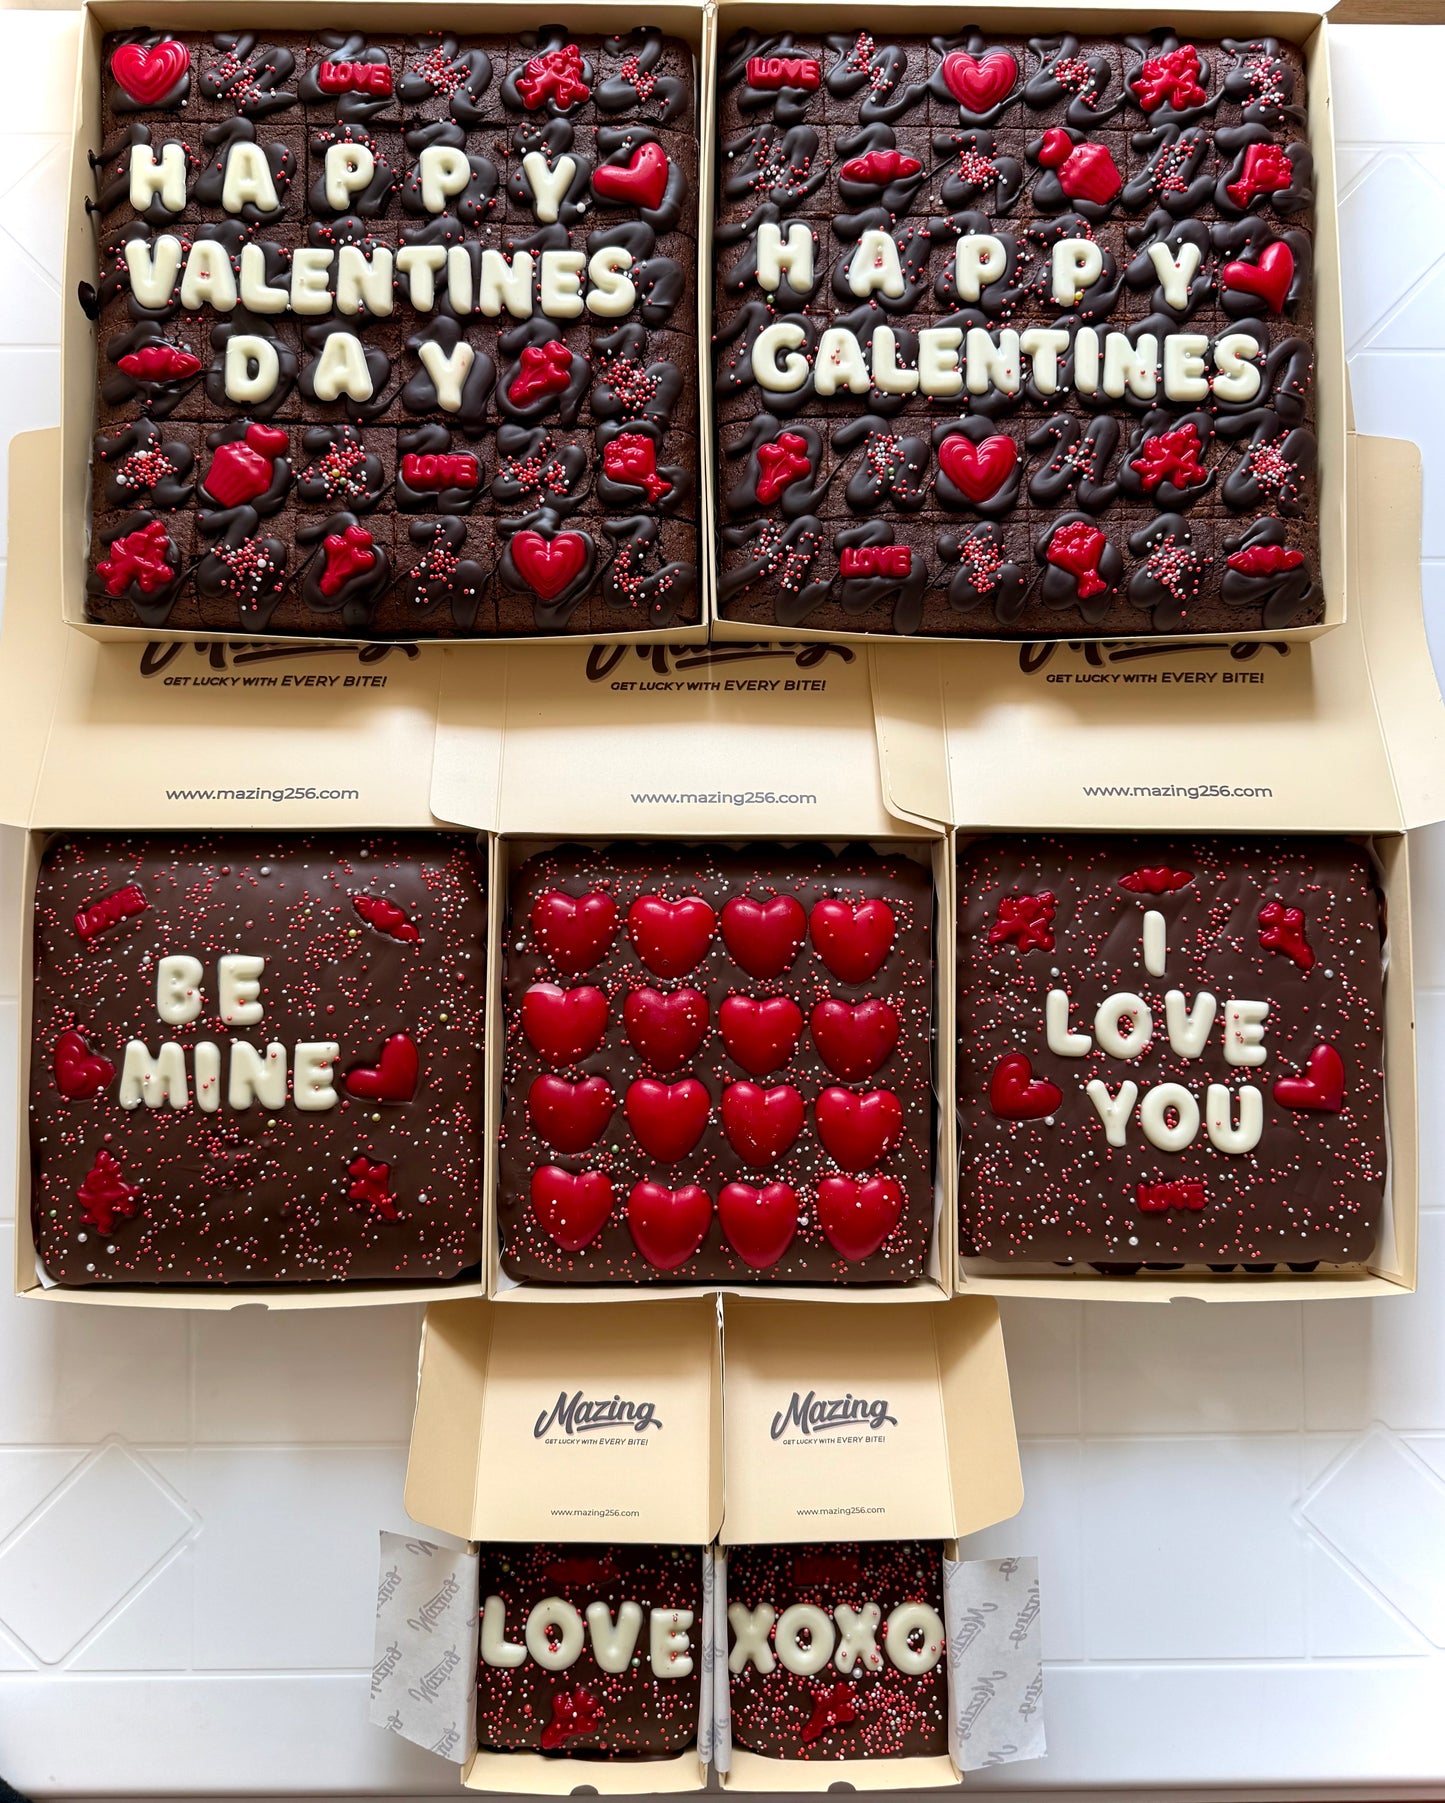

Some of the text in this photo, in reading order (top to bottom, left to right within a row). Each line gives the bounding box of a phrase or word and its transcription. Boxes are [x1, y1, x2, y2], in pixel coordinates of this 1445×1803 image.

[130, 142, 576, 223] HAPPY
[125, 235, 636, 318] VALENTINES
[757, 223, 1201, 310] HAPPY
[225, 331, 475, 412] DAY
[751, 323, 1261, 401] GALENTINES
[163, 675, 388, 688] GET LUCKY WITH EVERY BITE!
[611, 680, 826, 691] GET LUCKY WITH EVERY BITE!
[1046, 672, 1264, 683] GET LUCKY WITH EVERY BITE!
[166, 787, 359, 802] www.mazing256.com
[631, 791, 817, 806] www.mazing256.com
[1083, 784, 1273, 799] www.mazing256.com
[1143, 910, 1167, 978] I
[157, 955, 265, 1026] BE
[1046, 989, 1269, 1067] LOVE
[119, 1039, 341, 1113] MINE
[1086, 1079, 1264, 1155] YOU
[533, 1390, 662, 1438] Mazing
[599, 1438, 627, 1446] EVERY
[770, 1390, 898, 1440] Mazing
[836, 1436, 864, 1444] EVERY
[551, 1509, 640, 1518] www.mazing256.com
[797, 1507, 886, 1516] www.mazing256.com
[481, 1595, 694, 1679] LOVE
[727, 1600, 945, 1676] XOXO
